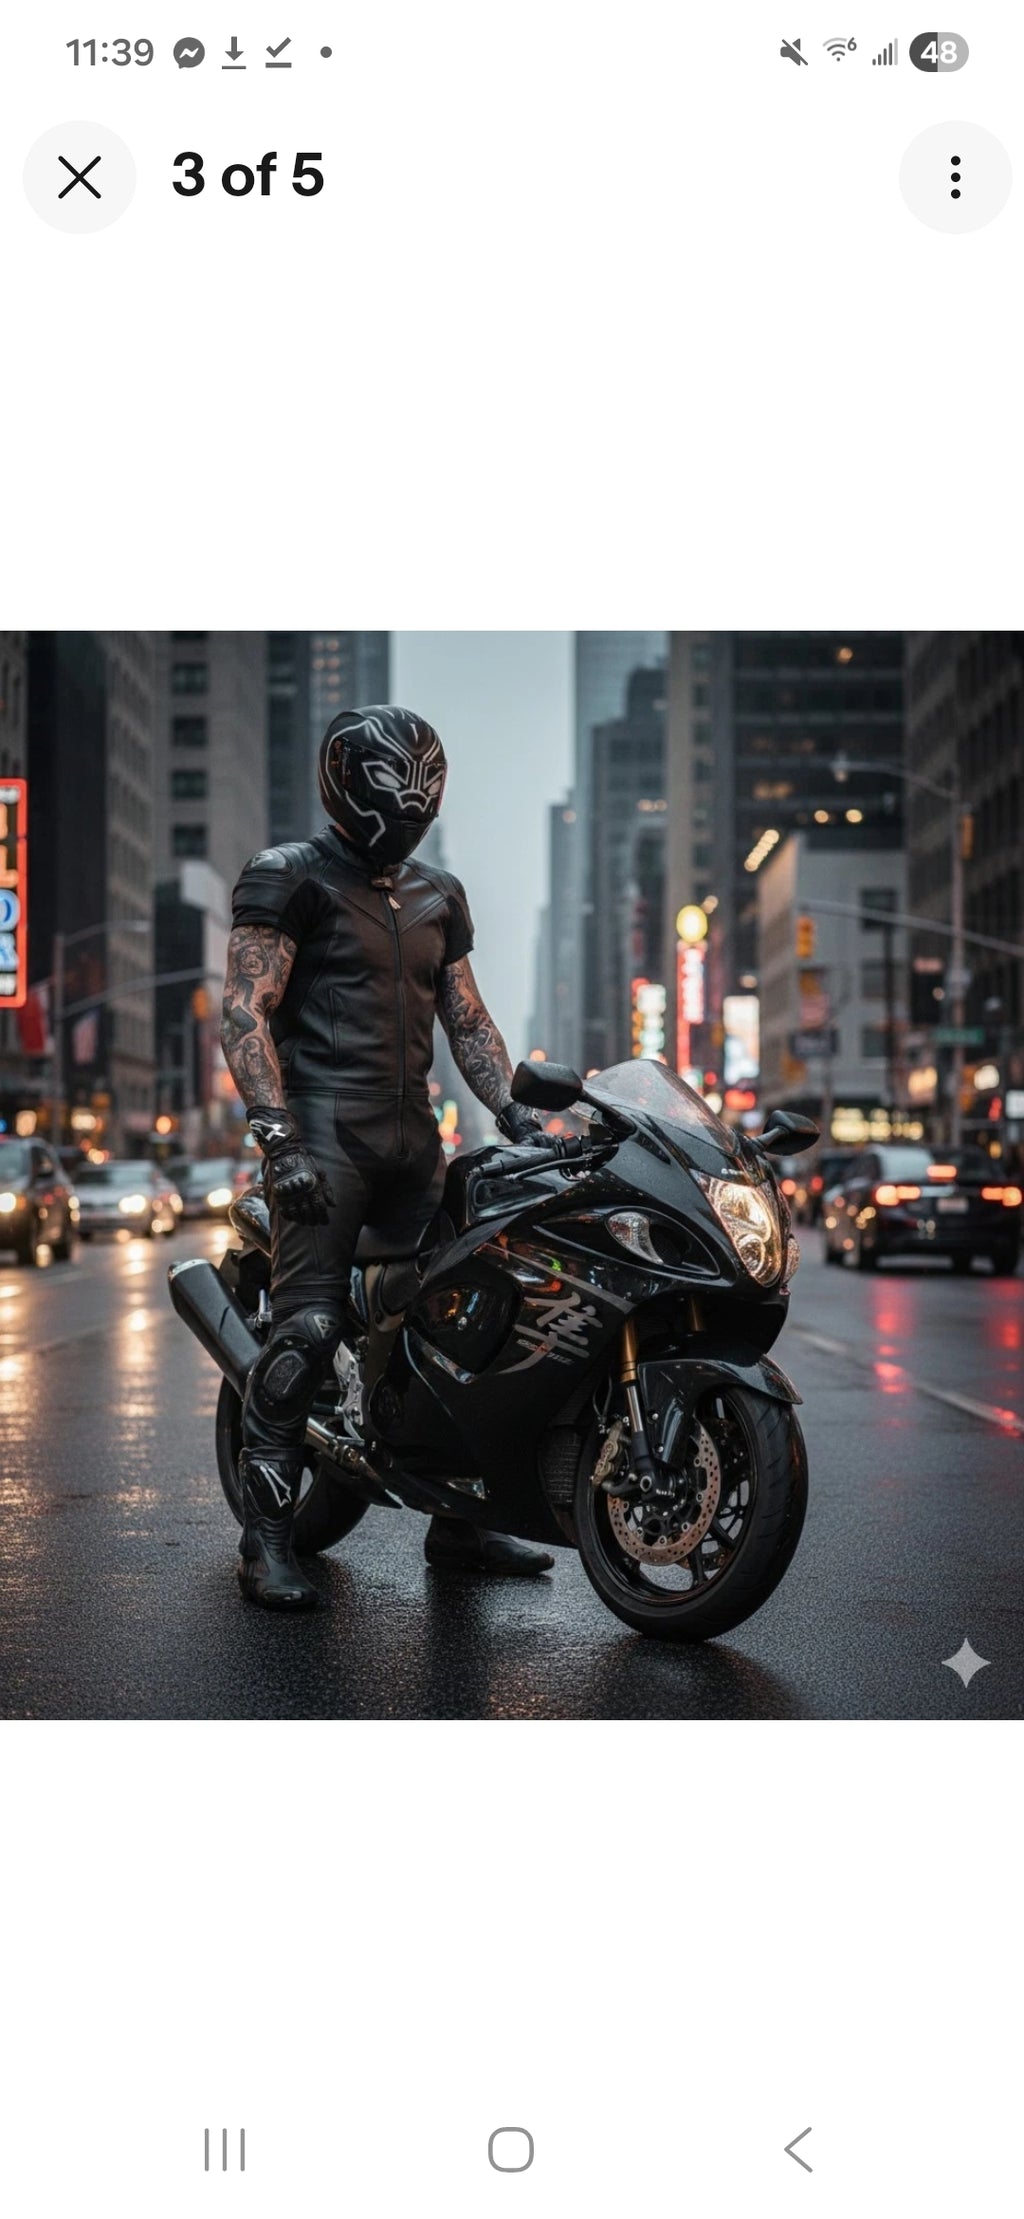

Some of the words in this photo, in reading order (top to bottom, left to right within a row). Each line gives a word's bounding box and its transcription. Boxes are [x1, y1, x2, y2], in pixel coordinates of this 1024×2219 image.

[66, 38, 154, 67] 11:39
[847, 37, 858, 51] 6
[920, 40, 958, 64] 48
[172, 151, 206, 197] 3
[221, 151, 278, 197] of
[291, 152, 325, 197] 5
